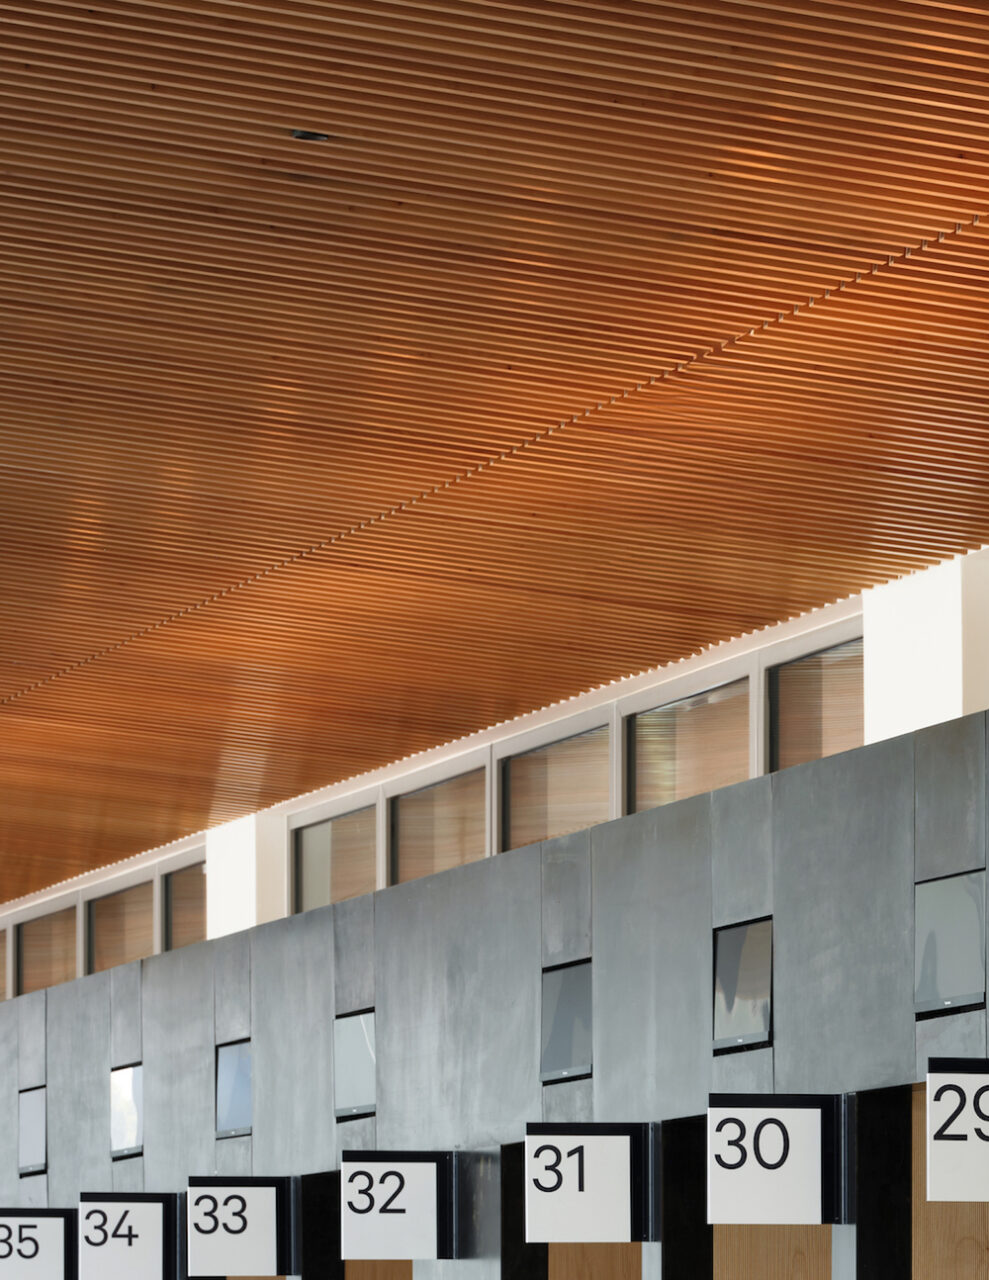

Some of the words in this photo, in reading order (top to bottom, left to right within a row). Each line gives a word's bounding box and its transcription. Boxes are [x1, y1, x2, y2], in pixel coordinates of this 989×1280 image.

[714, 1117, 790, 1171] 30
[532, 1144, 586, 1193] 31
[193, 1194, 249, 1235] 33
[347, 1170, 408, 1215] 32
[84, 1209, 139, 1247] 34
